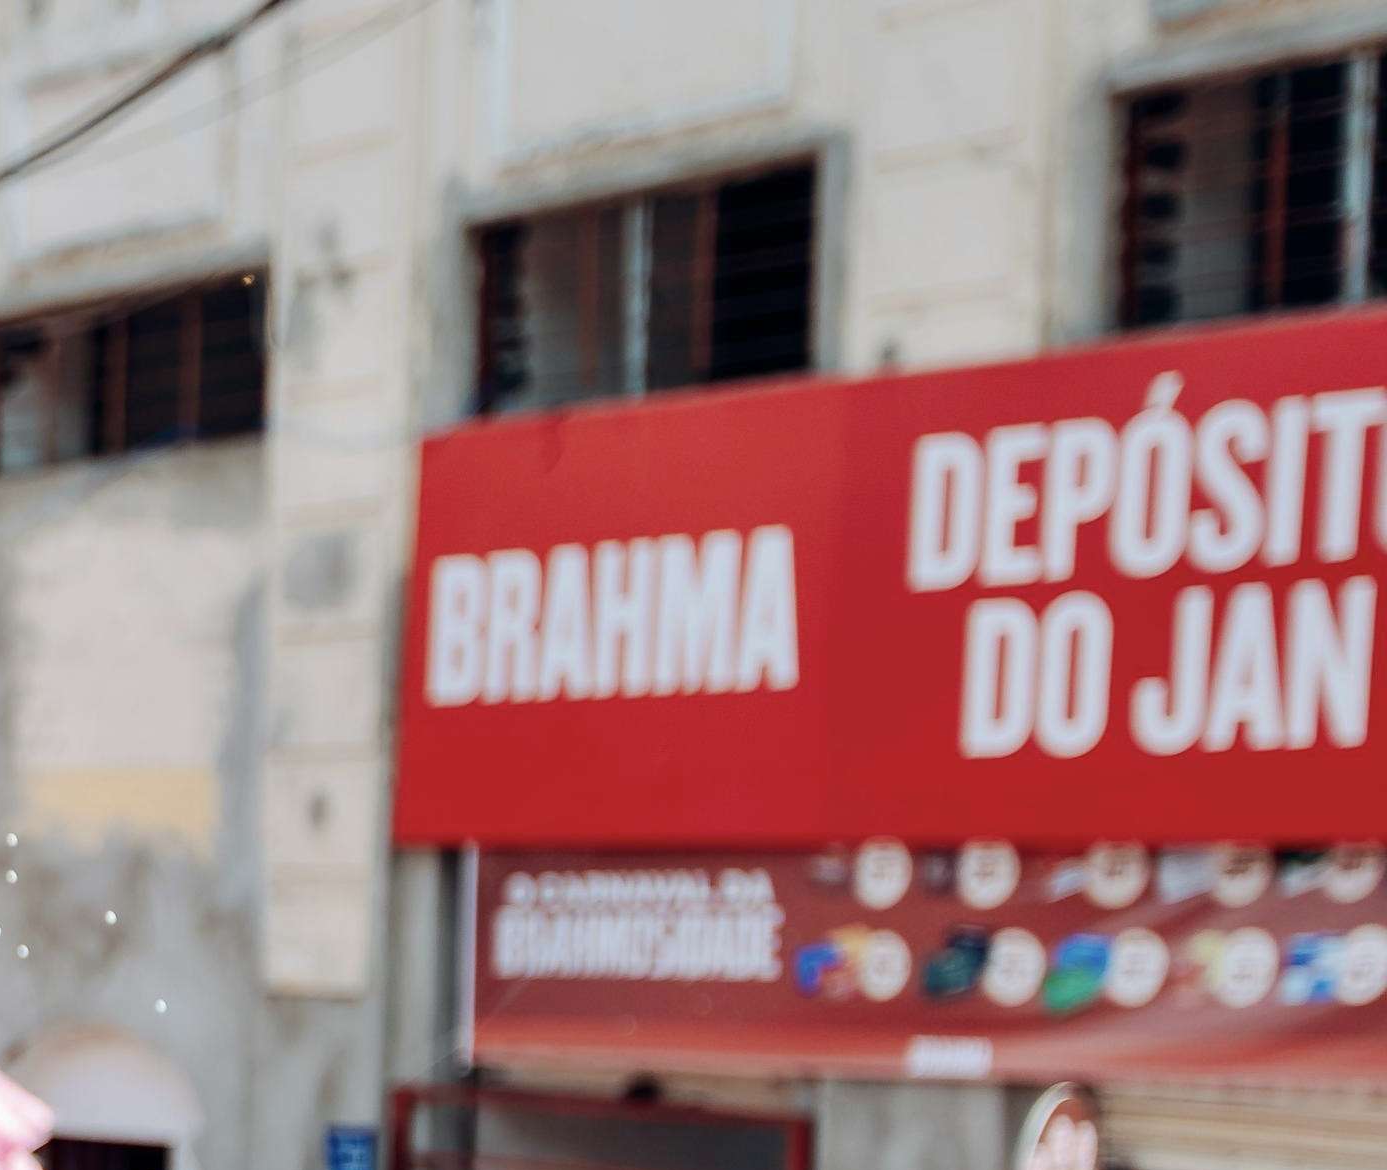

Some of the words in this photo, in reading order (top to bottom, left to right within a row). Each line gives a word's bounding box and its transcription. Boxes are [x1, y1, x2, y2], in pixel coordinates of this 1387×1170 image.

[907, 370, 1387, 593] DEPÓSIT
[426, 524, 800, 708] BRAHMA
[960, 590, 1114, 760] DO
[1131, 575, 1378, 757] JAN
